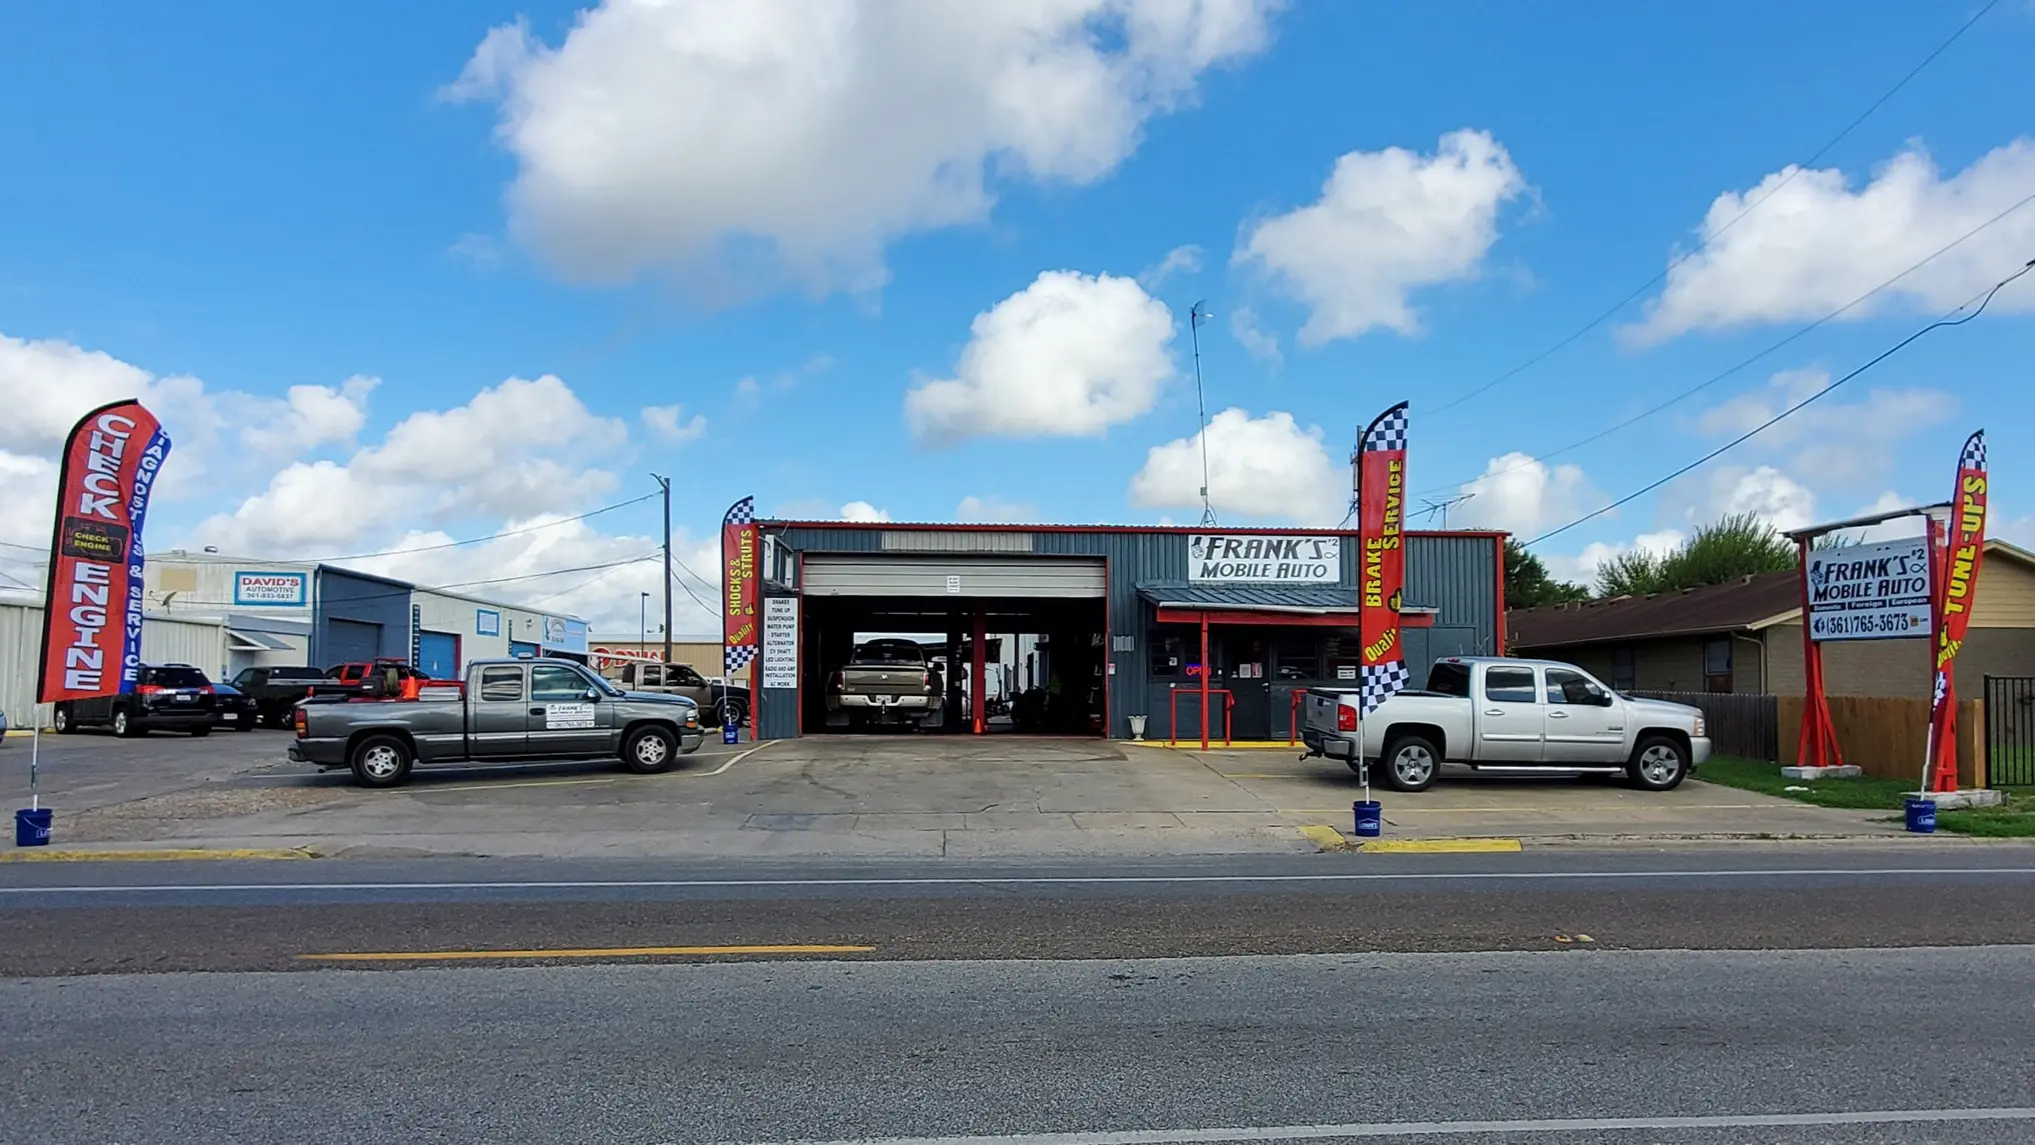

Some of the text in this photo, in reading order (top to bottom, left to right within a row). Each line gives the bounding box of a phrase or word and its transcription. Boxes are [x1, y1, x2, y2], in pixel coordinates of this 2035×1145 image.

[80, 414, 136, 520] CHECK
[1382, 460, 1402, 550] SERVICE
[74, 532, 109, 543] CHECK
[74, 540, 112, 552] ENGINE
[1204, 537, 1327, 560] FRANK'S
[1944, 475, 1986, 616] TUNE-UPS
[124, 427, 170, 681] DIAGNOSTCS & SERVICE
[740, 530, 753, 578] STRUTS
[242, 577, 299, 586] DAVID'S
[1200, 562, 1328, 578] MOBILE AUTO
[1365, 537, 1382, 607] BRAKE
[1824, 555, 1910, 584] FRANK'S
[729, 568, 741, 616] SHOCKS
[1813, 577, 1926, 602] MOBILE AUTO
[1851, 601, 1883, 609] Foreign
[1892, 598, 1928, 606] European
[64, 561, 110, 690] ENGINE
[729, 622, 753, 645] Quality
[1826, 613, 1909, 635] (361)765-3673
[1364, 628, 1396, 662] Quali
